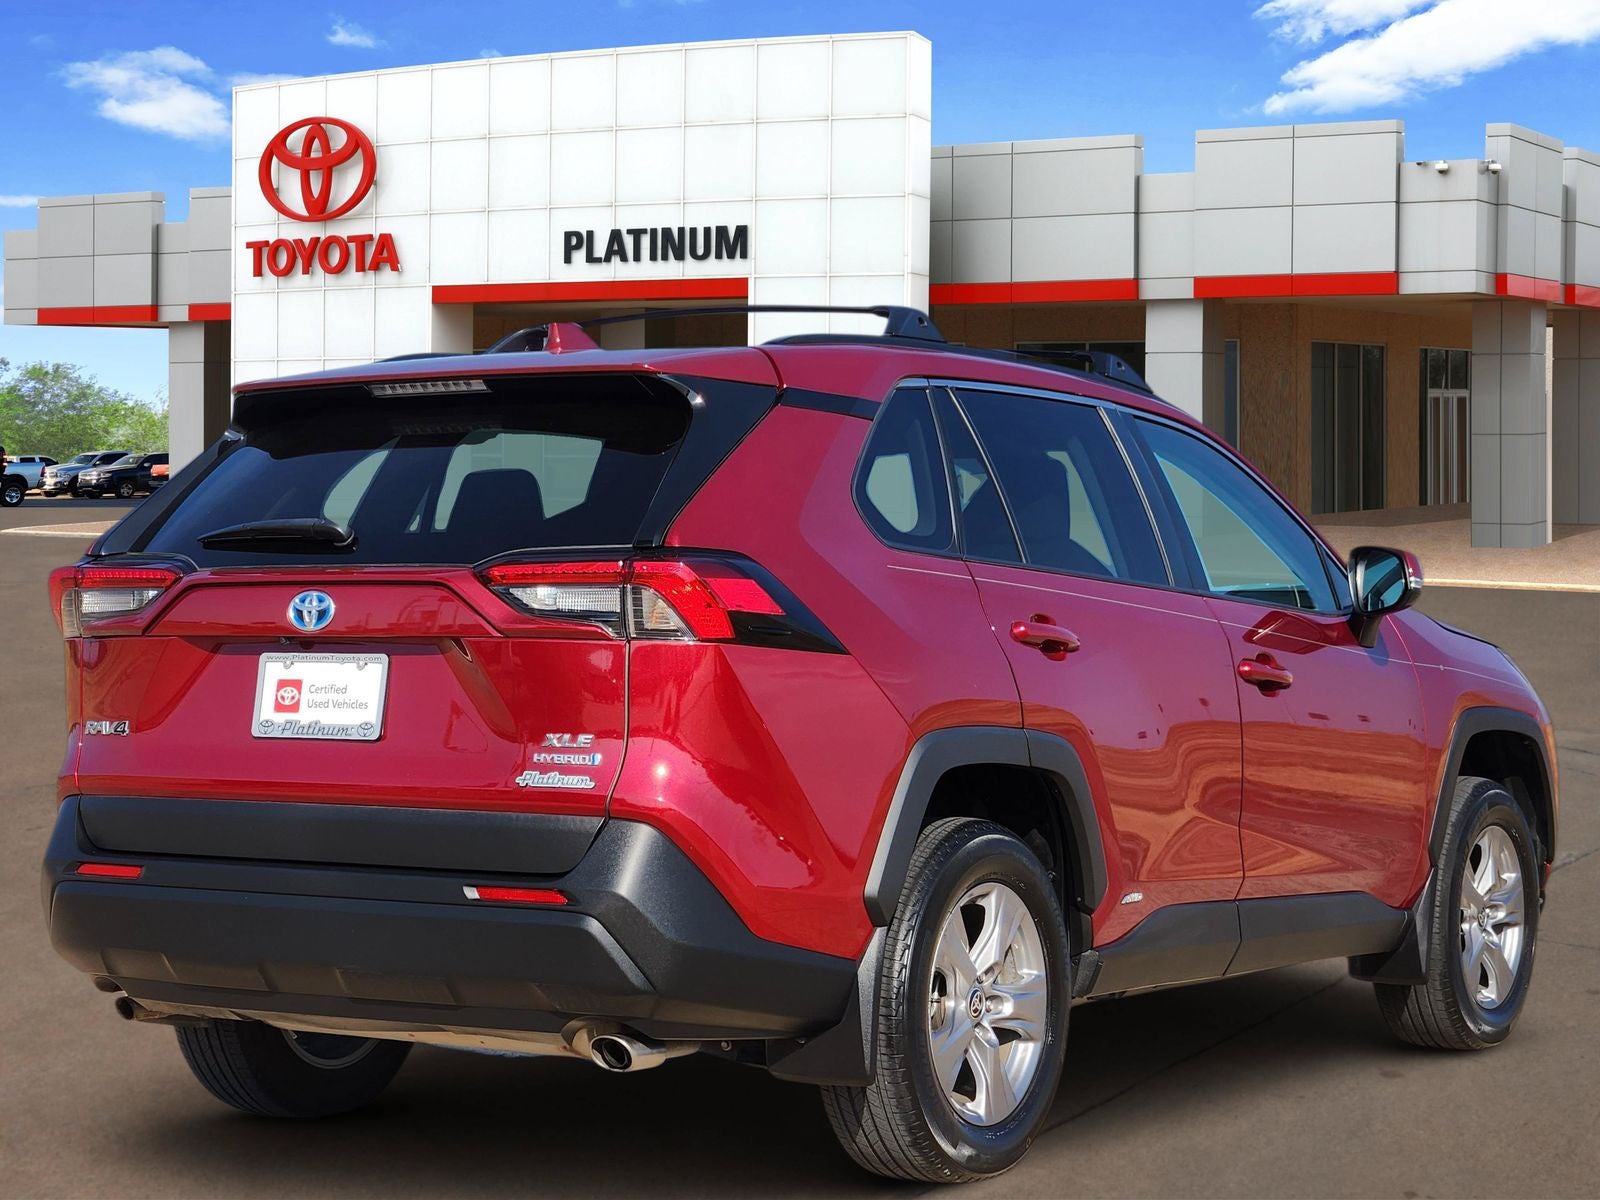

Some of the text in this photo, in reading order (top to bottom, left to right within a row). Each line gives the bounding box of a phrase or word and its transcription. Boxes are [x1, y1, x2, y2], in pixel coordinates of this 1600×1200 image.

[563, 224, 749, 264] PLATINUM
[246, 233, 402, 278] TOYOTA
[266, 654, 382, 662] www.PlatinumToyota.com
[308, 684, 348, 695] Certified
[307, 699, 369, 710] Used Vehicles
[85, 720, 129, 736] RAV4
[280, 720, 353, 737] Platinum
[542, 733, 595, 747] XLE
[533, 753, 591, 765] HYBRID
[516, 771, 595, 788] Platinum
